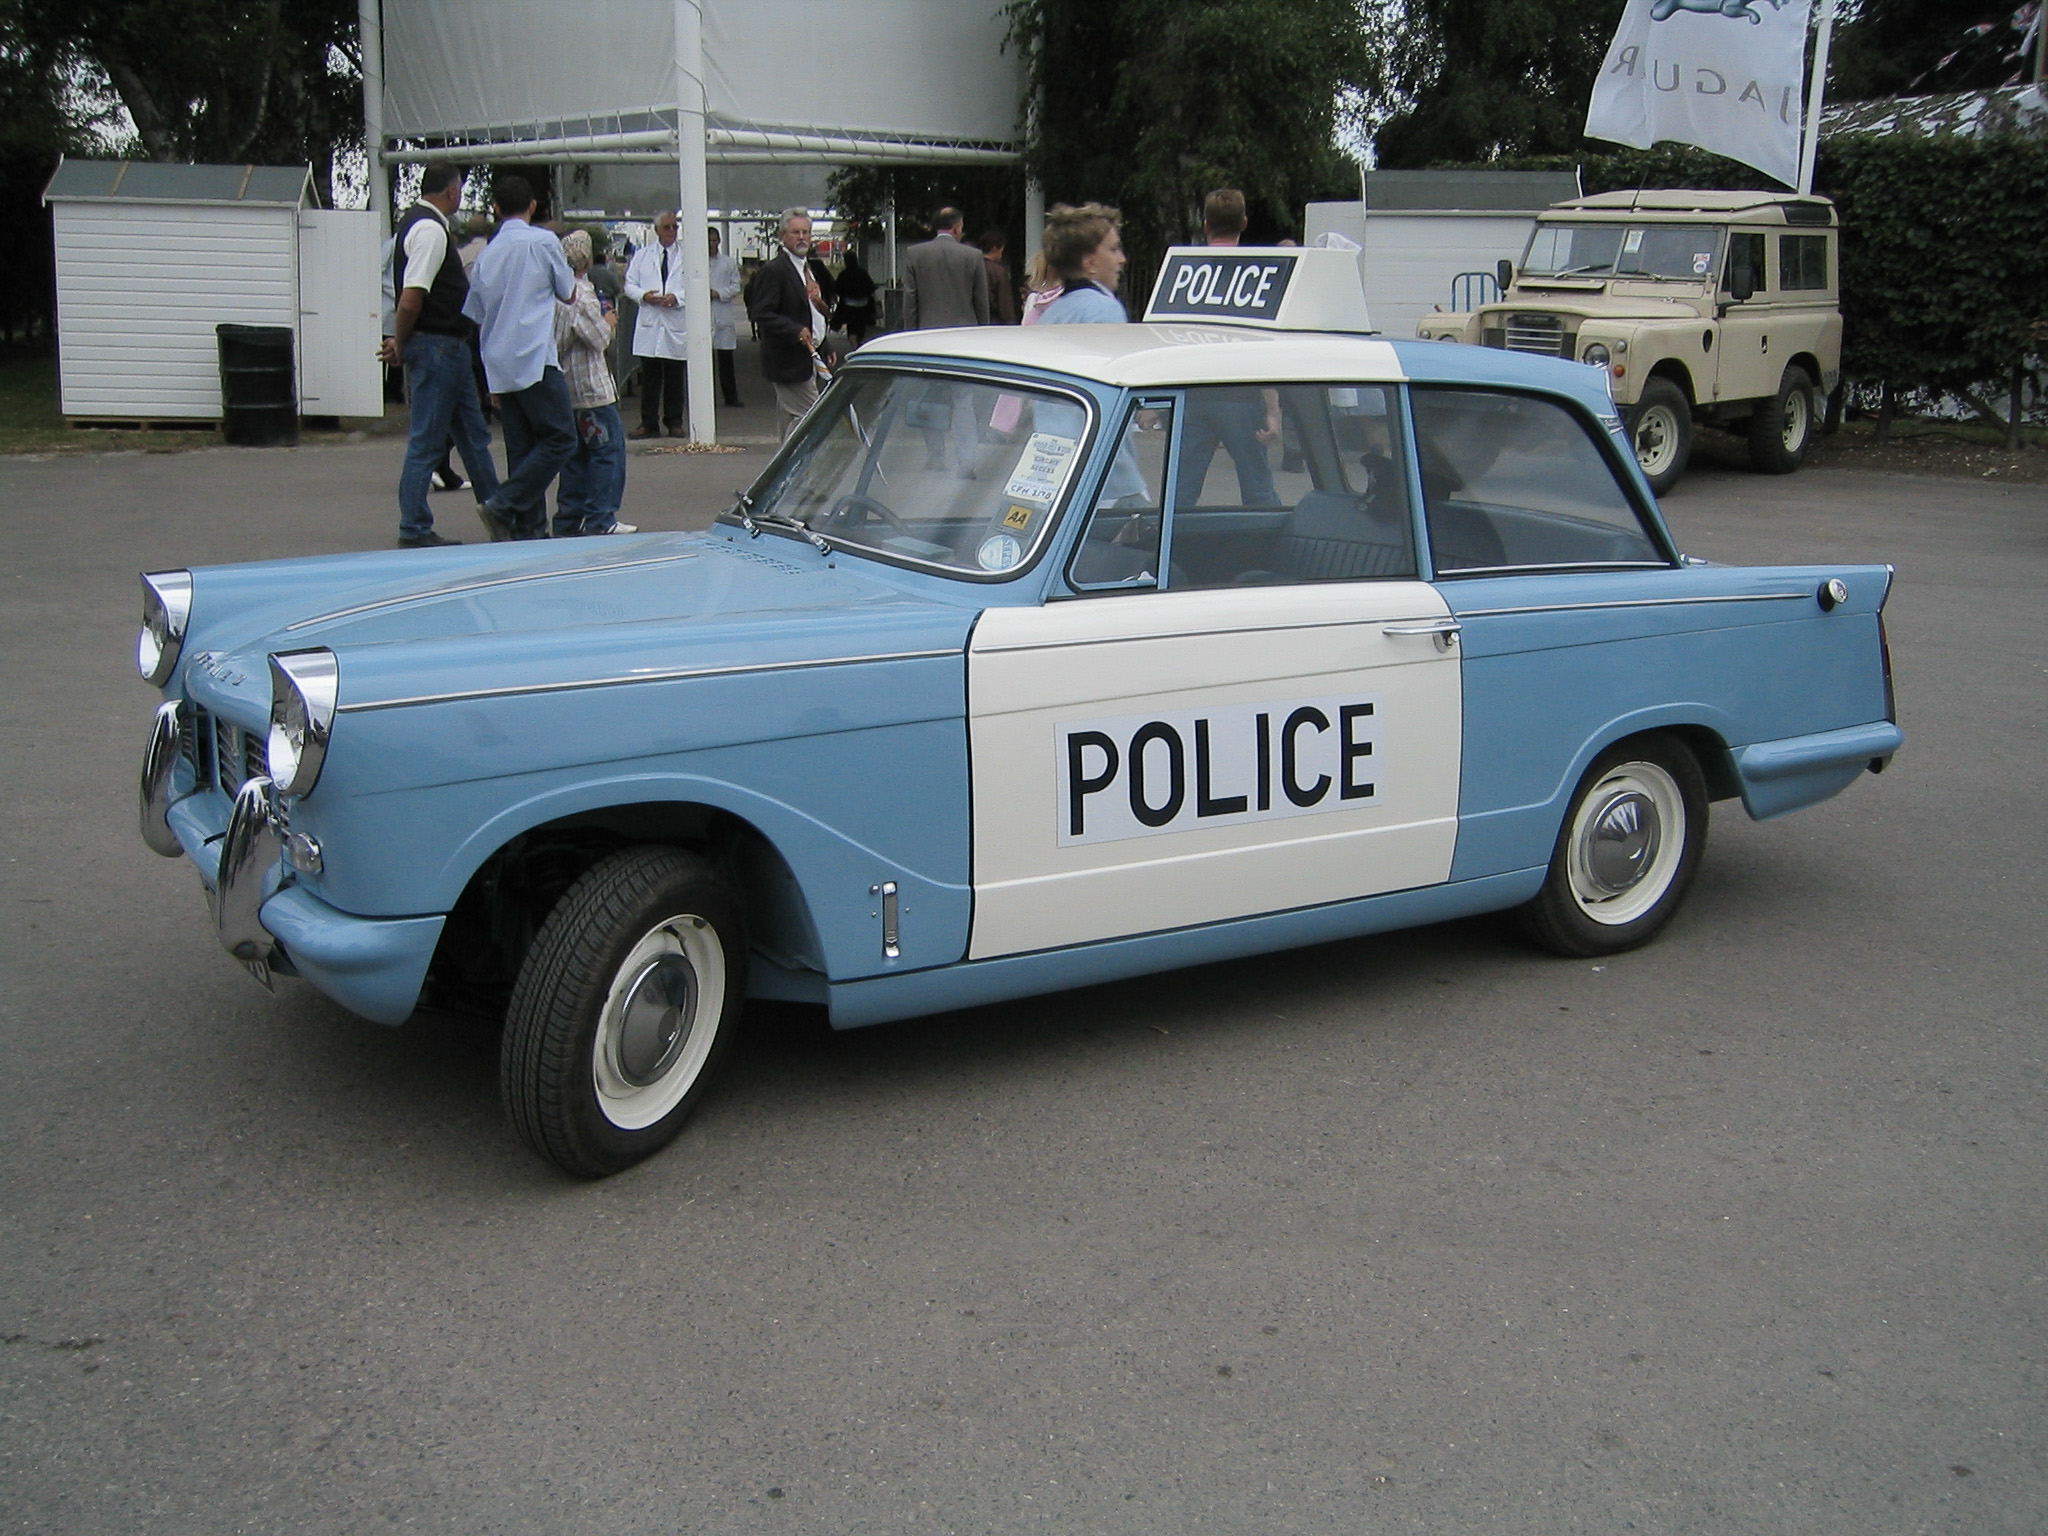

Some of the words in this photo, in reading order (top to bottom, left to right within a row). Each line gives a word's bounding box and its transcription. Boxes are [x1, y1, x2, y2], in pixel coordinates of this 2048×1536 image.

[1168, 263, 1278, 308] POLICE
[1007, 511, 1028, 525] AA
[1067, 702, 1375, 836] POLICE
